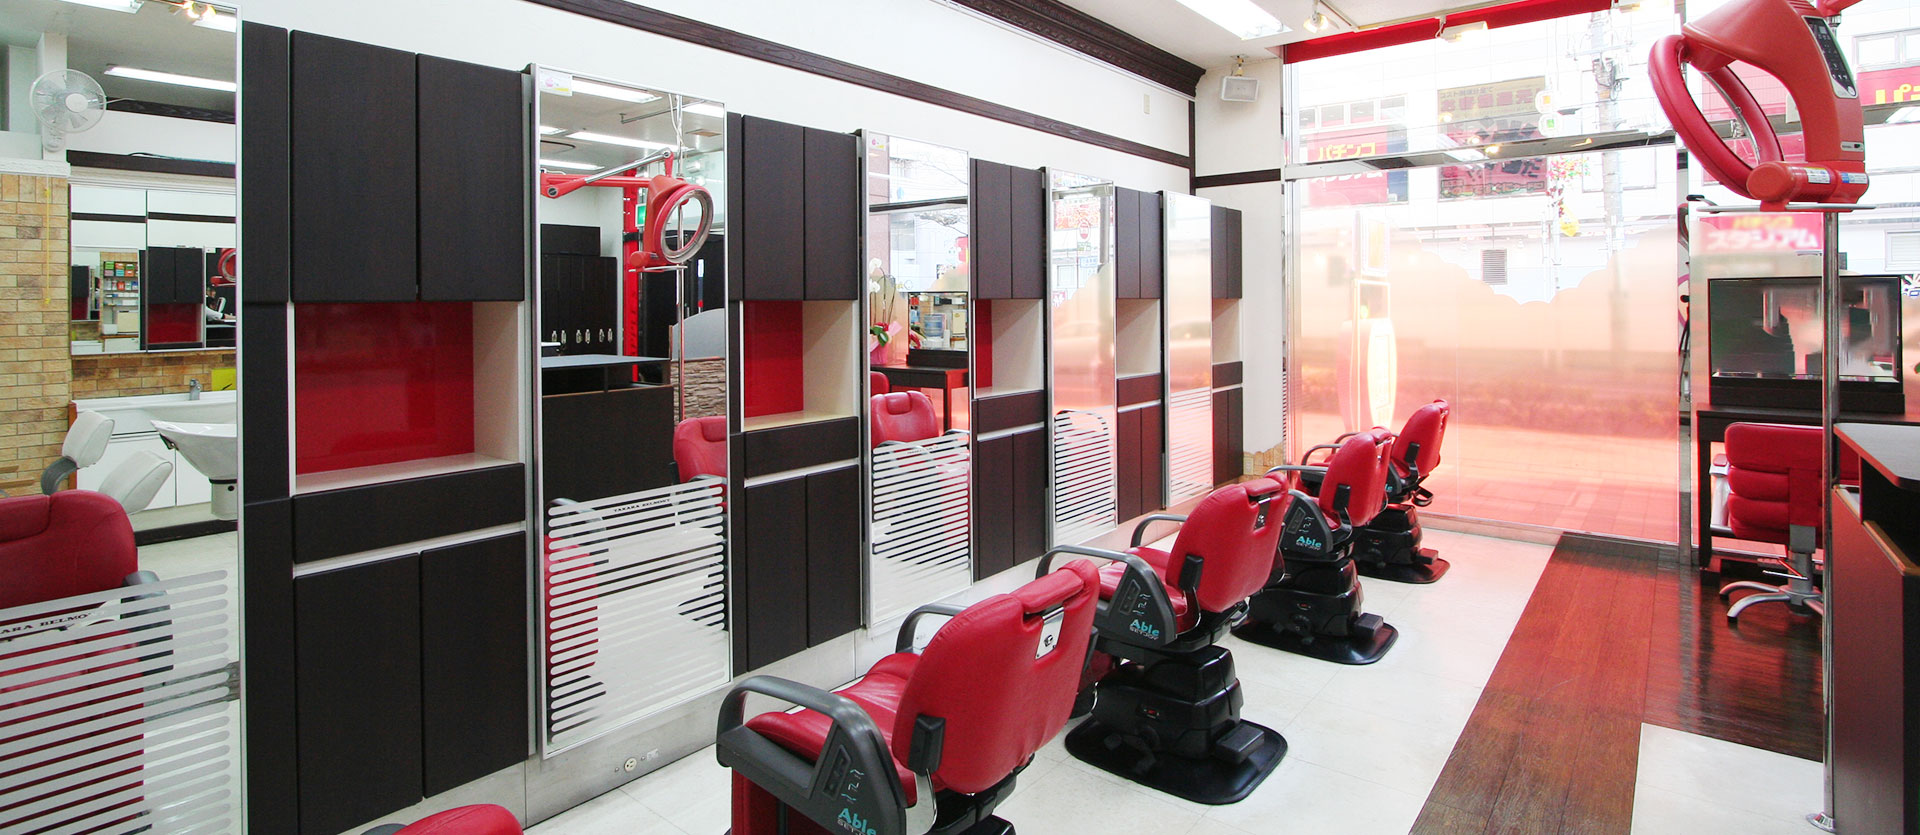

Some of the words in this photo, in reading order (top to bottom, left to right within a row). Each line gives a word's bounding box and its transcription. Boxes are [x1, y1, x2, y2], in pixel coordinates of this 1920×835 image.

[1318, 142, 1376, 160] パチンコ
[1296, 535, 1322, 548] Able
[40, 613, 93, 627] BELMO
[1130, 619, 1160, 637] Able
[837, 808, 877, 835] Able
